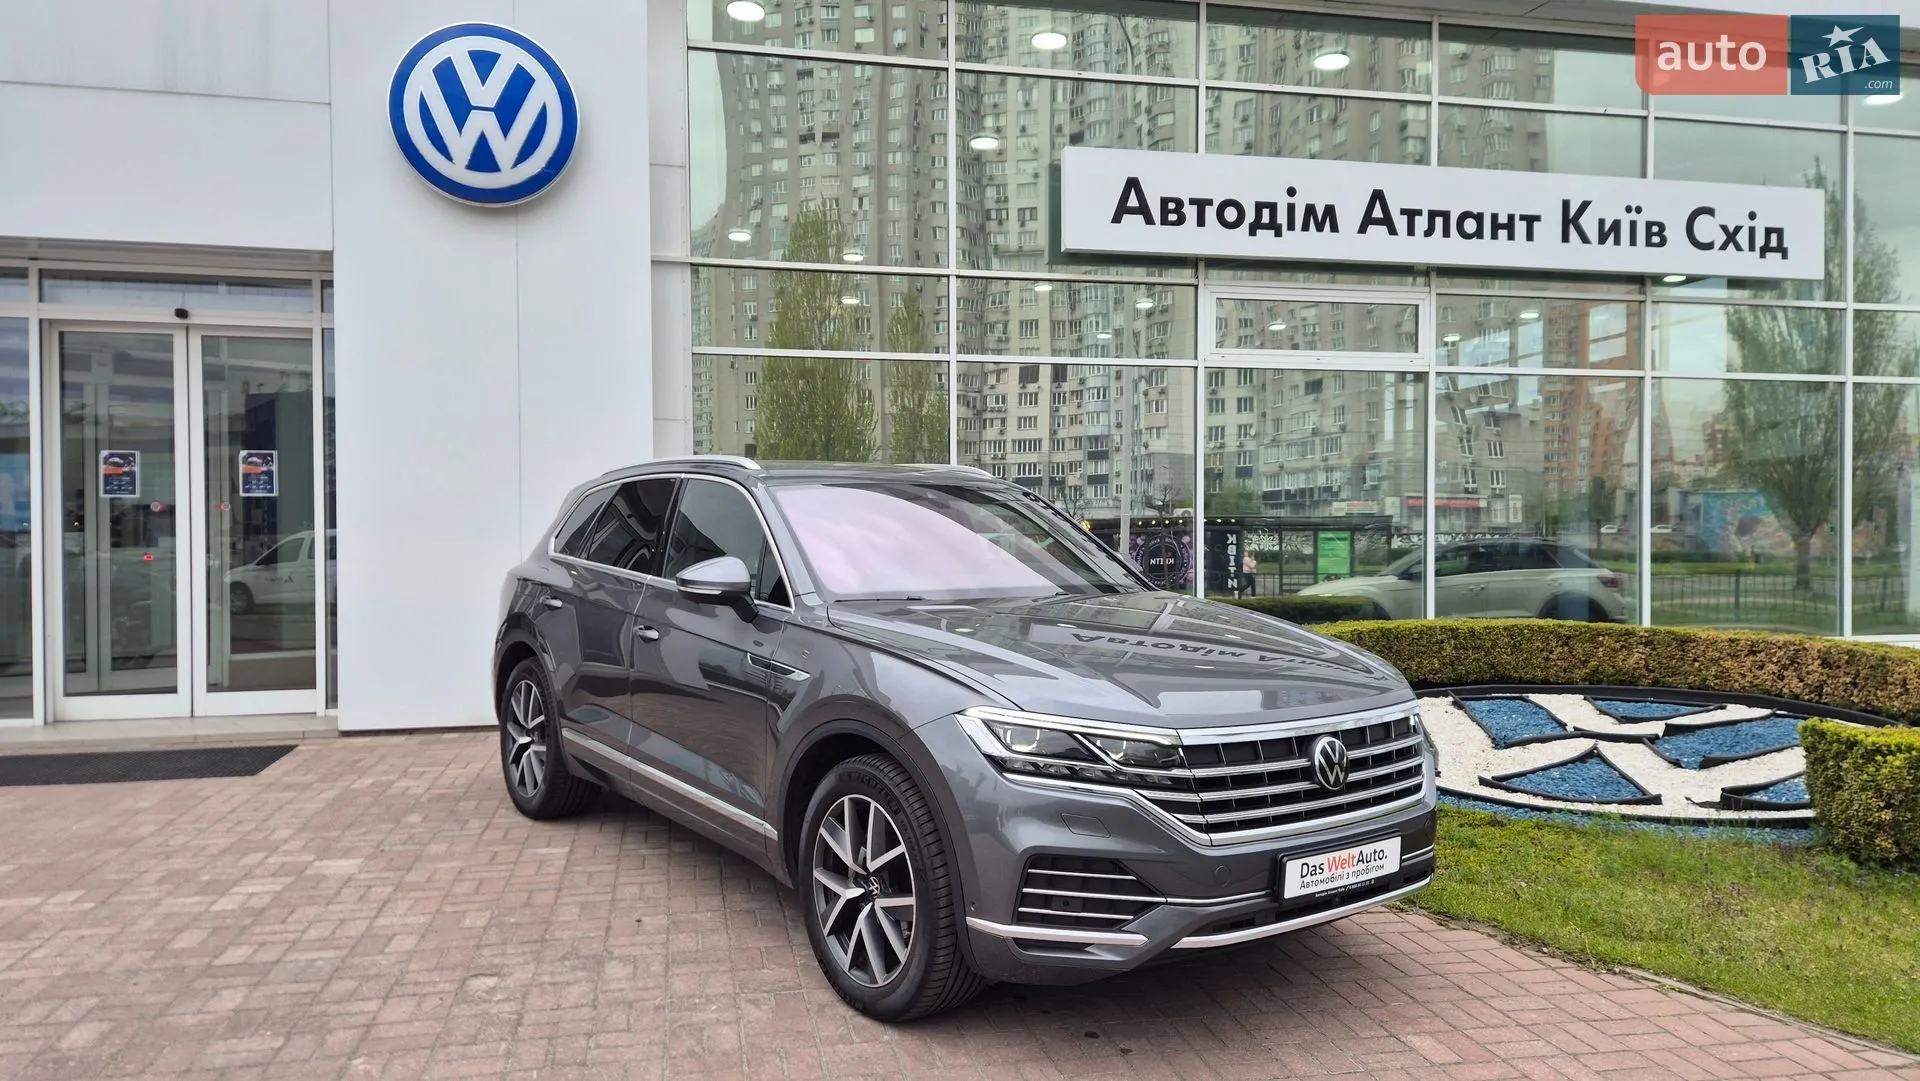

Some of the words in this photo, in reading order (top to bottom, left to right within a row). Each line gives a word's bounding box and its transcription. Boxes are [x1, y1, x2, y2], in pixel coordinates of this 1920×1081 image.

[403, 36, 563, 189] VW
[1110, 176, 1339, 237] Автодім
[1357, 188, 1541, 242] Атлант
[1560, 199, 1668, 248] Київ
[1685, 205, 1789, 260] Схід
[1315, 736, 1347, 790] VW
[1300, 862, 1325, 879] Das
[1300, 871, 1345, 890] Автомобілі
[1345, 872, 1350, 880] з
[1351, 864, 1385, 879] пробігом
